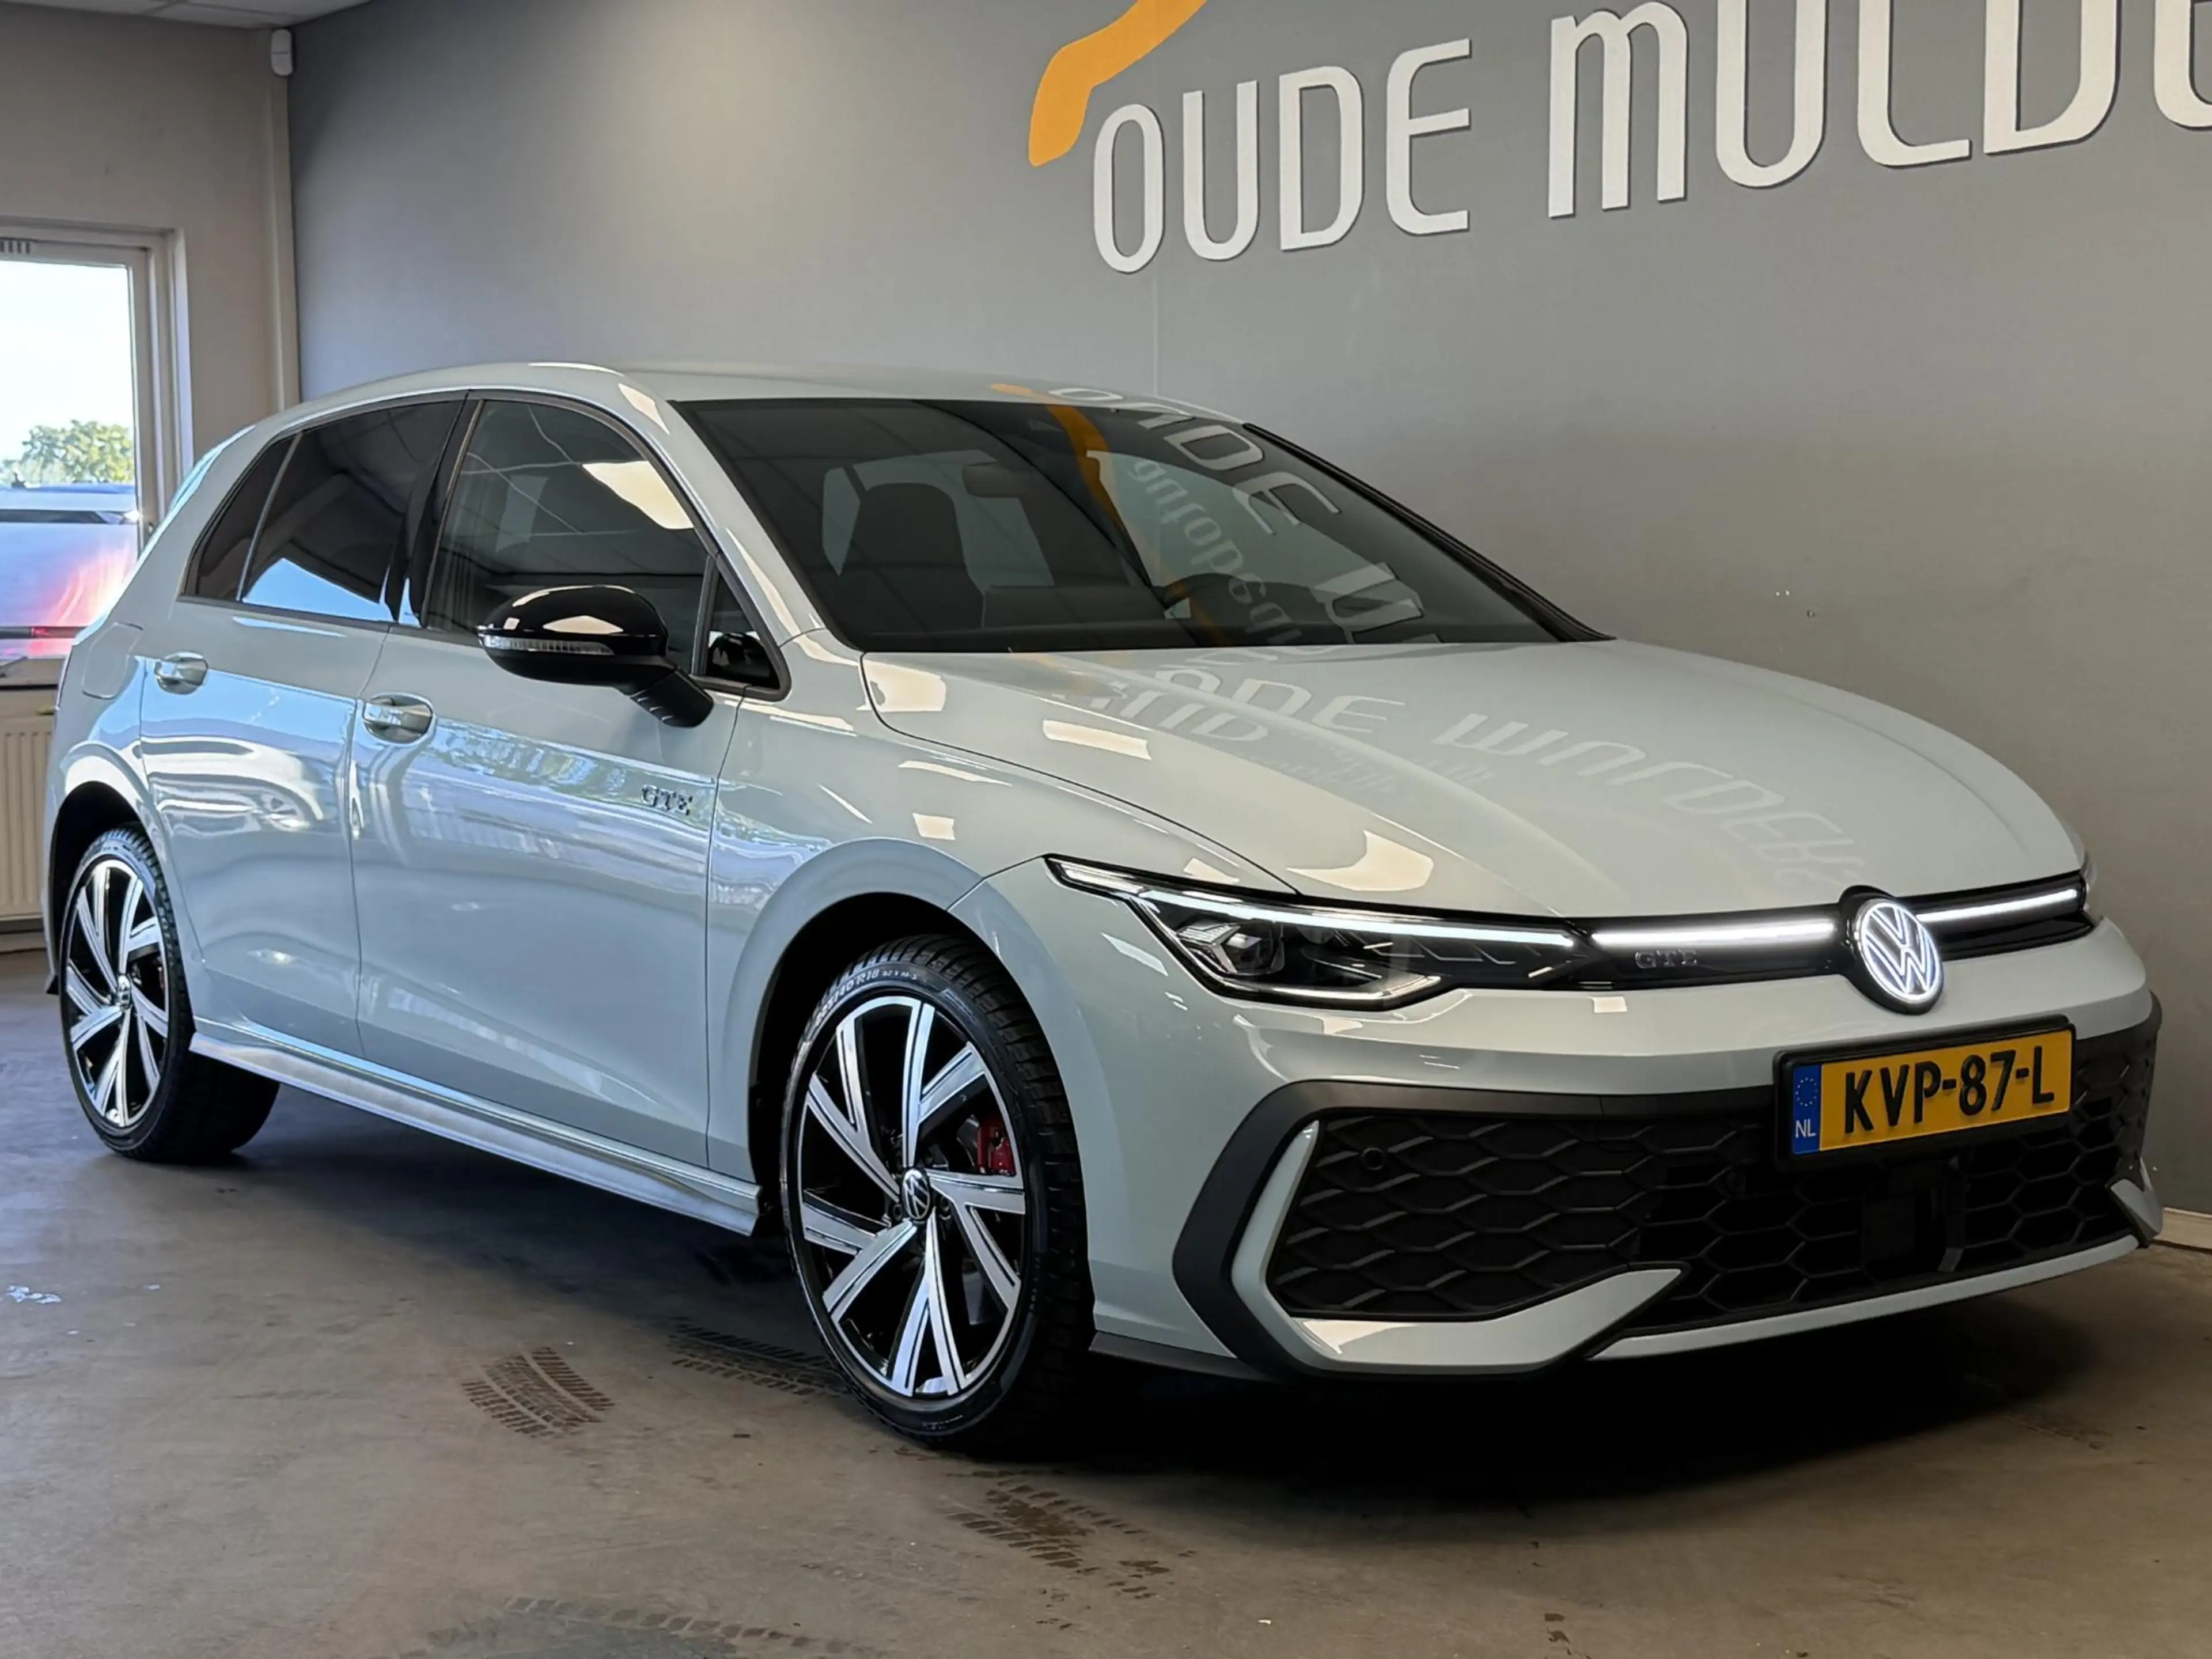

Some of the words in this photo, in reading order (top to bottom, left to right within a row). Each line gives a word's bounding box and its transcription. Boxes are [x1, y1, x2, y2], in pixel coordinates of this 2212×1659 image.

[1093, 38, 1471, 274] OUDE
[1795, 1119, 1816, 1139] NL
[1845, 1046, 2055, 1134] KVP-87-L
